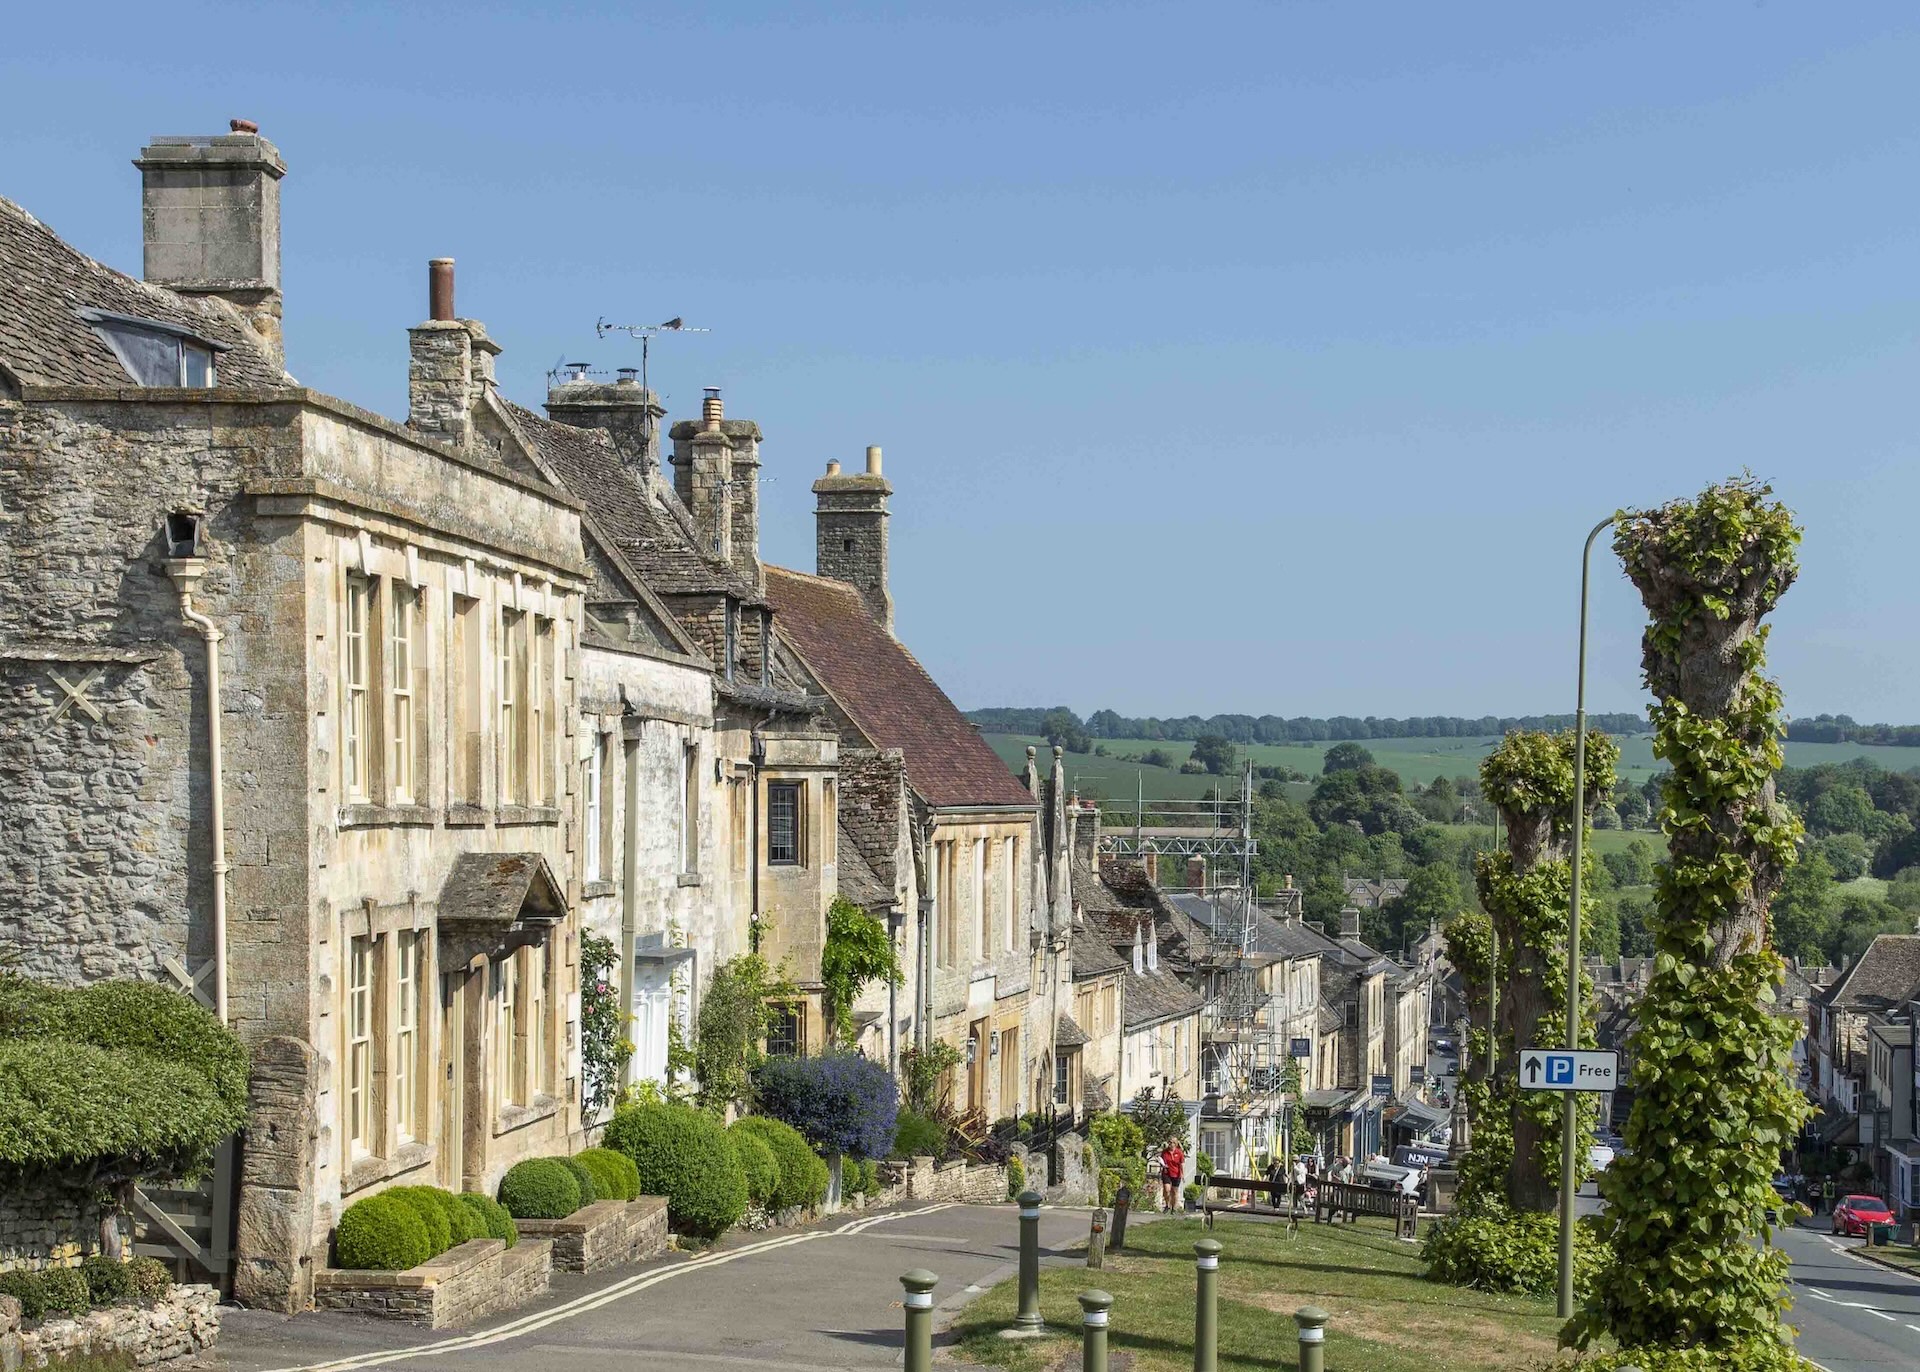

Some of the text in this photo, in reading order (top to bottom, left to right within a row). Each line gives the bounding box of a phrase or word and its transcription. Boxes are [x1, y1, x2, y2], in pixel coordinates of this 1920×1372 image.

[1552, 1059, 1611, 1081] P Free
[1408, 1153, 1428, 1164] NJN
